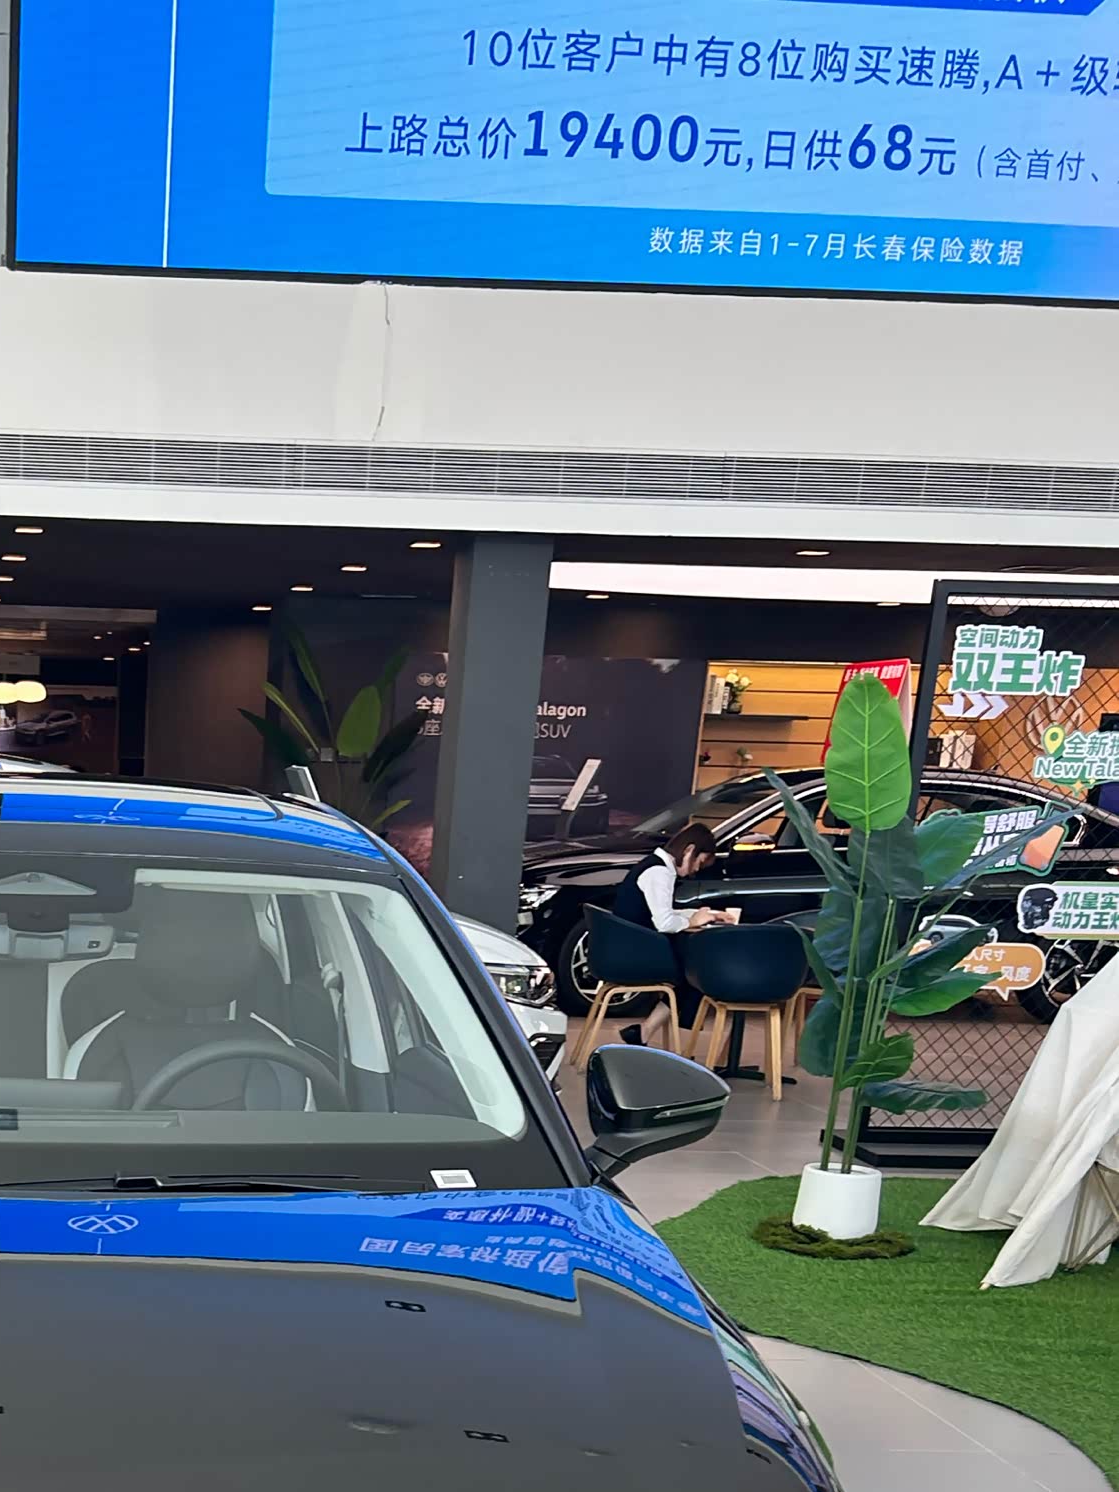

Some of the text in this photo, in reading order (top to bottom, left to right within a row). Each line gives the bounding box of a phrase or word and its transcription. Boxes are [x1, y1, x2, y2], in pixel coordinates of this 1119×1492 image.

[462, 27, 1119, 97] 10位客户中有8位购买速腾,A+级
[648, 226, 1024, 267] 数据来自1-7月长春保险数据
[958, 627, 1041, 649] 空间动力
[951, 652, 1083, 694] 双王炸
[534, 722, 571, 738] SUV
[1036, 759, 1082, 777] New
